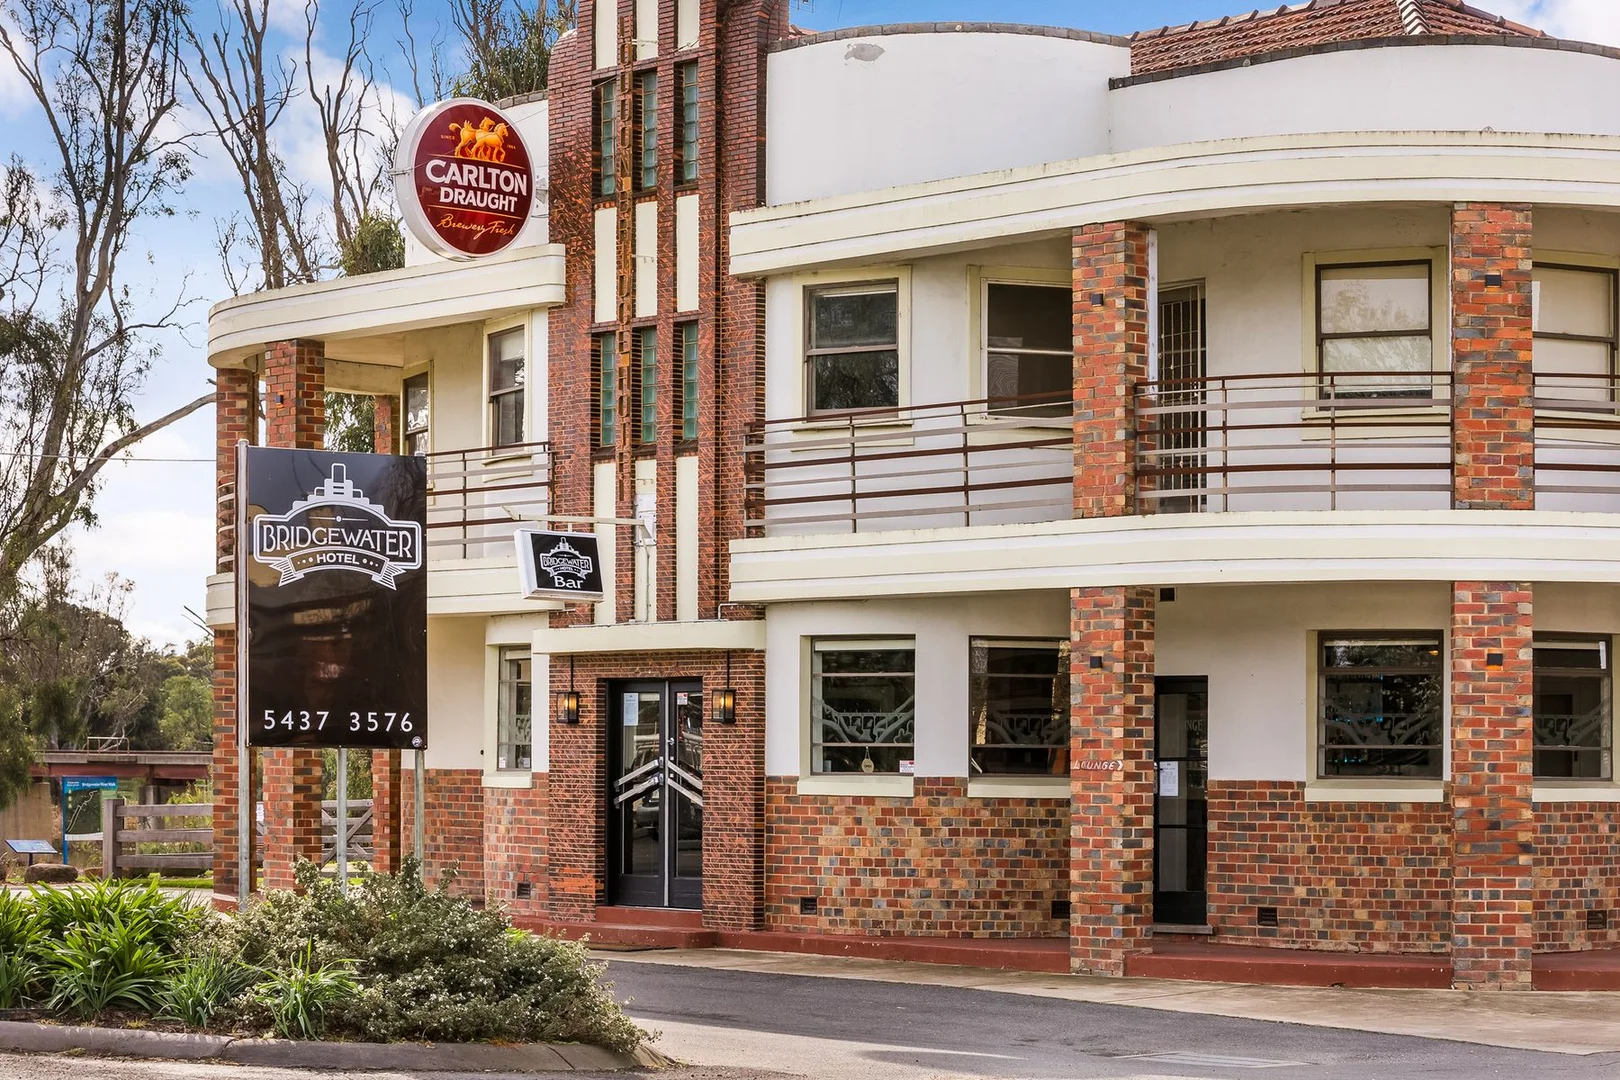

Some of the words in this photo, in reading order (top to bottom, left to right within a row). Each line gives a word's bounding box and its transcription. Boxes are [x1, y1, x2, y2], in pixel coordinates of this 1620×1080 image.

[619, 15, 632, 176] LODDON
[425, 159, 527, 196] CARLTON
[439, 187, 518, 213] DRAUGHT
[436, 213, 490, 240] Brewery
[489, 219, 515, 236] Fresh
[618, 190, 632, 353] BRIDGE
[618, 366, 631, 501] HOTEL
[262, 524, 413, 558] BRIDGEWATER
[316, 553, 360, 565] HOTEL
[542, 556, 590, 570] BRIDGEWATER
[554, 575, 584, 589] Bar
[264, 709, 329, 731] 5437
[350, 711, 413, 732] 3576
[1073, 760, 1115, 770] LOUNGE
